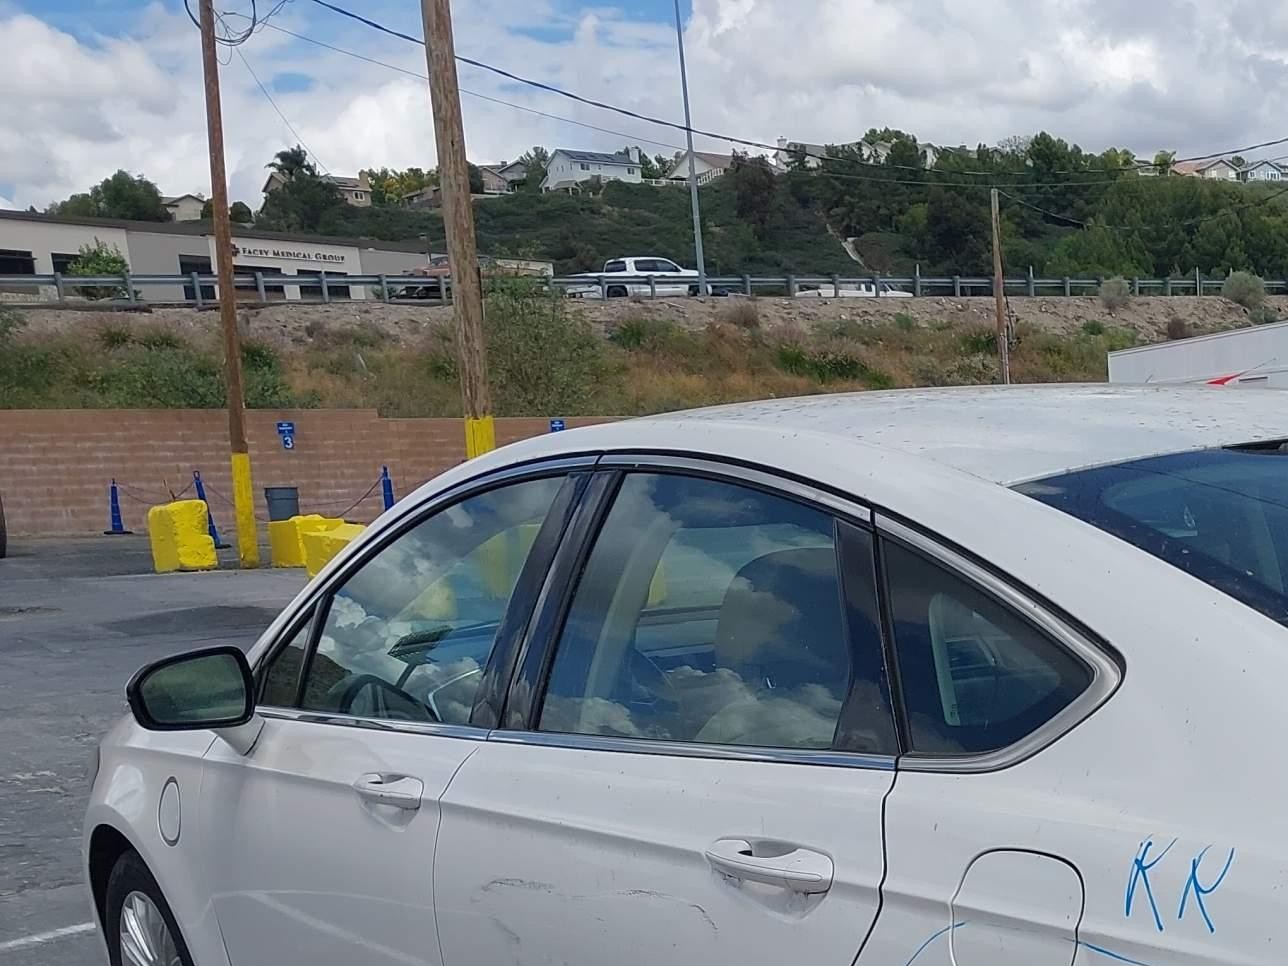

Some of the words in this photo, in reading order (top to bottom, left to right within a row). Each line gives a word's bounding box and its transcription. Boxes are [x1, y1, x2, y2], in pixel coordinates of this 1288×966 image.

[242, 247, 269, 257] FACEY
[272, 250, 311, 260] MEDICAL
[284, 436, 293, 449] 3
